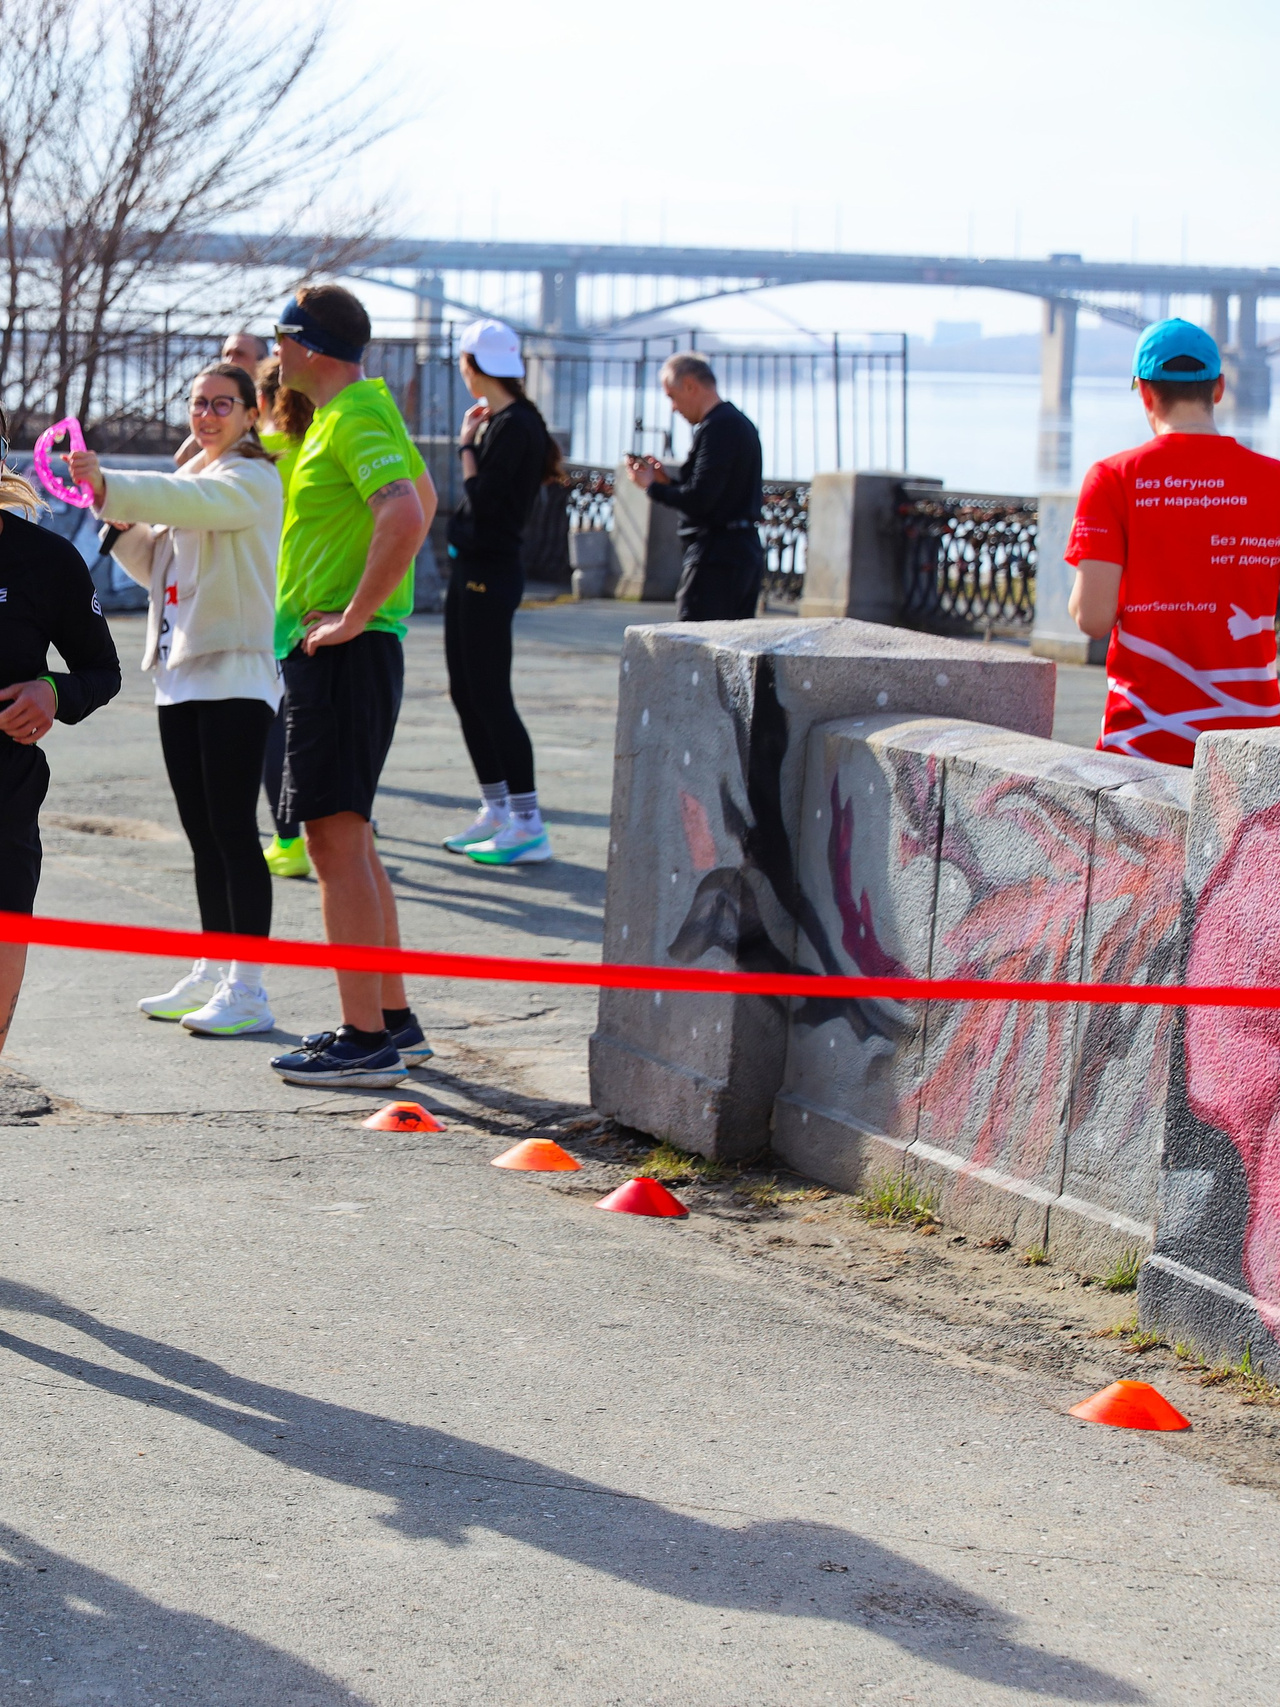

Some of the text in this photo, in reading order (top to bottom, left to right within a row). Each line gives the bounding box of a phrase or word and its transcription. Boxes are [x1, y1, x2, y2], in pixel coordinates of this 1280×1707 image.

[1135, 475, 1225, 491] Без бегунов
[1135, 494, 1248, 509] нет марафонов
[1210, 534, 1237, 547] Без
[1210, 554, 1236, 566] нет
